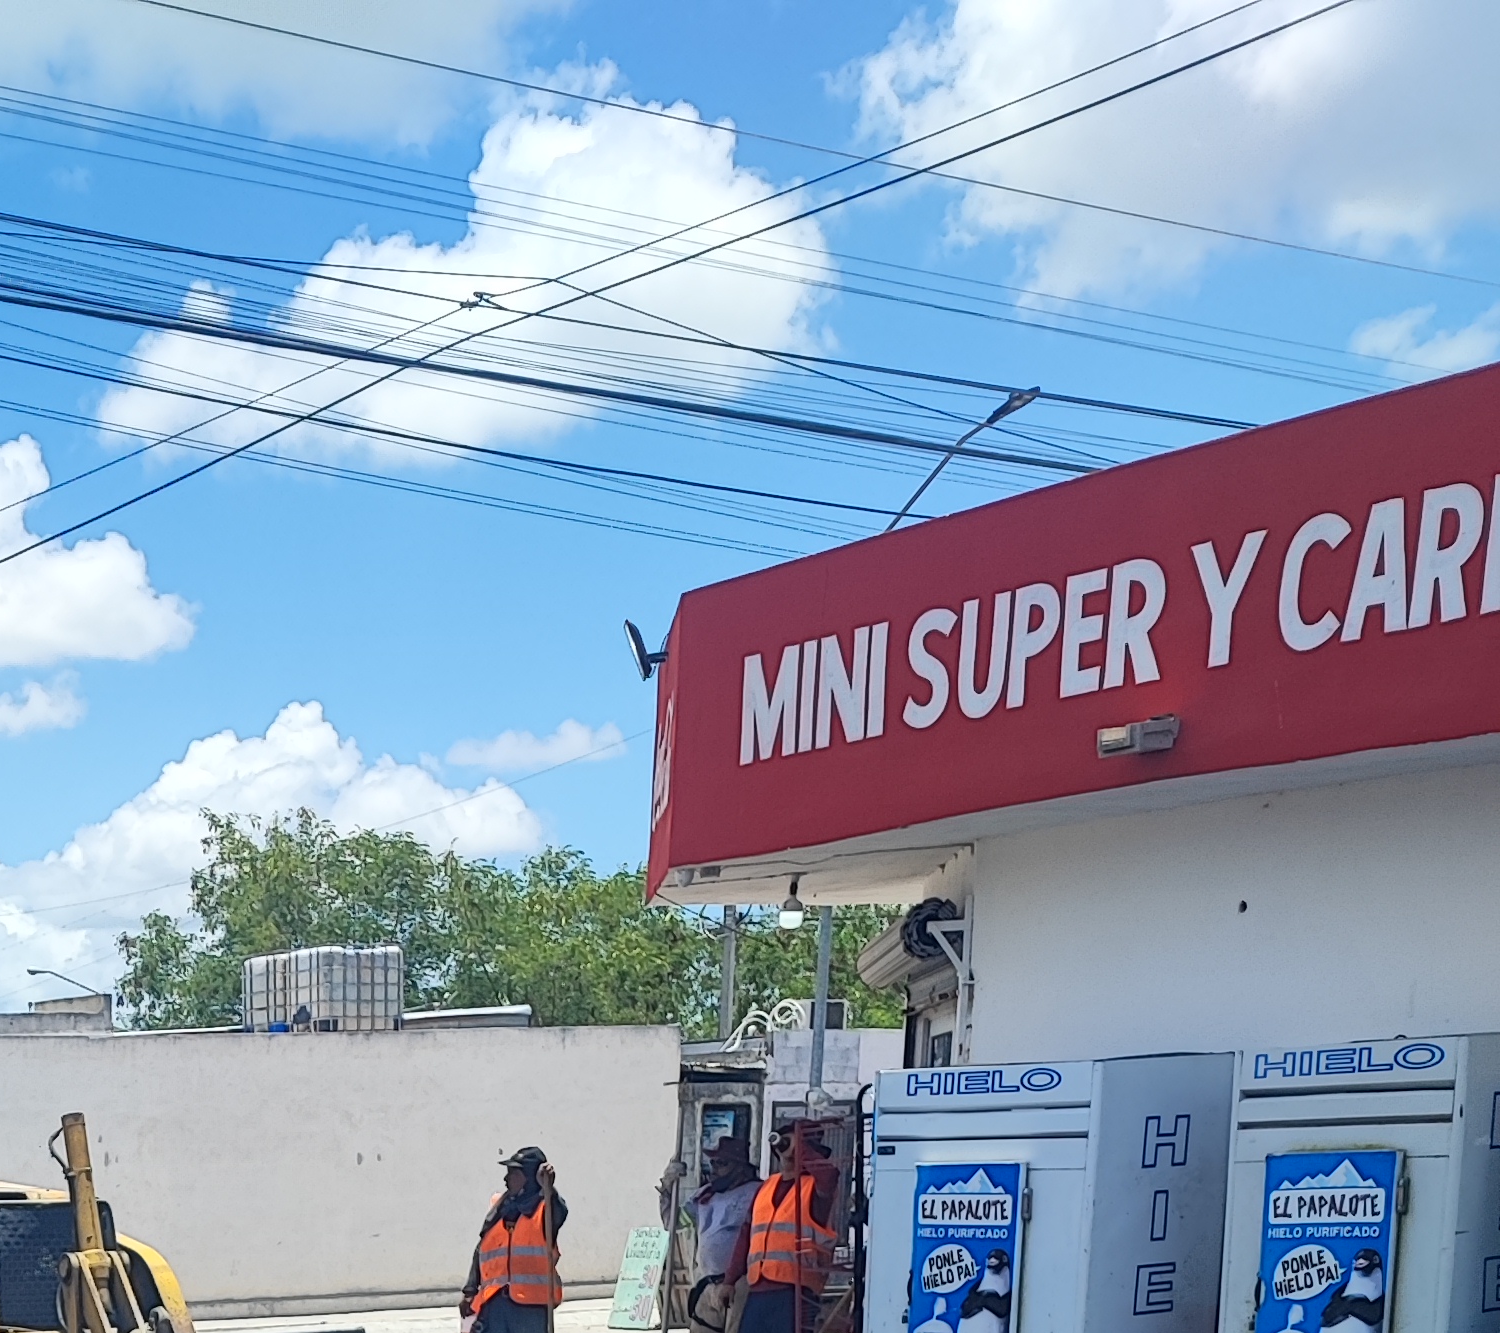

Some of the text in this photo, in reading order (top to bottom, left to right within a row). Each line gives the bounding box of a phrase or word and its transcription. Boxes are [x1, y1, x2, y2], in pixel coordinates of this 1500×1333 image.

[738, 622, 889, 766] MINI
[902, 557, 1167, 730] SUPER
[1189, 528, 1268, 669] Y
[1278, 473, 1500, 652] CAR
[1254, 1043, 1445, 1079] HIELO
[907, 1067, 1062, 1096] HIELO
[921, 1199, 1008, 1220] EL PAPALOTE
[1273, 1193, 1380, 1218] EL PAPALOTE
[917, 1227, 1008, 1239] HIELO PURIFICADO
[1267, 1226, 1380, 1239] HIELO PURIFICADO
[928, 1248, 965, 1272] PONLE
[1281, 1250, 1326, 1277] PONLE
